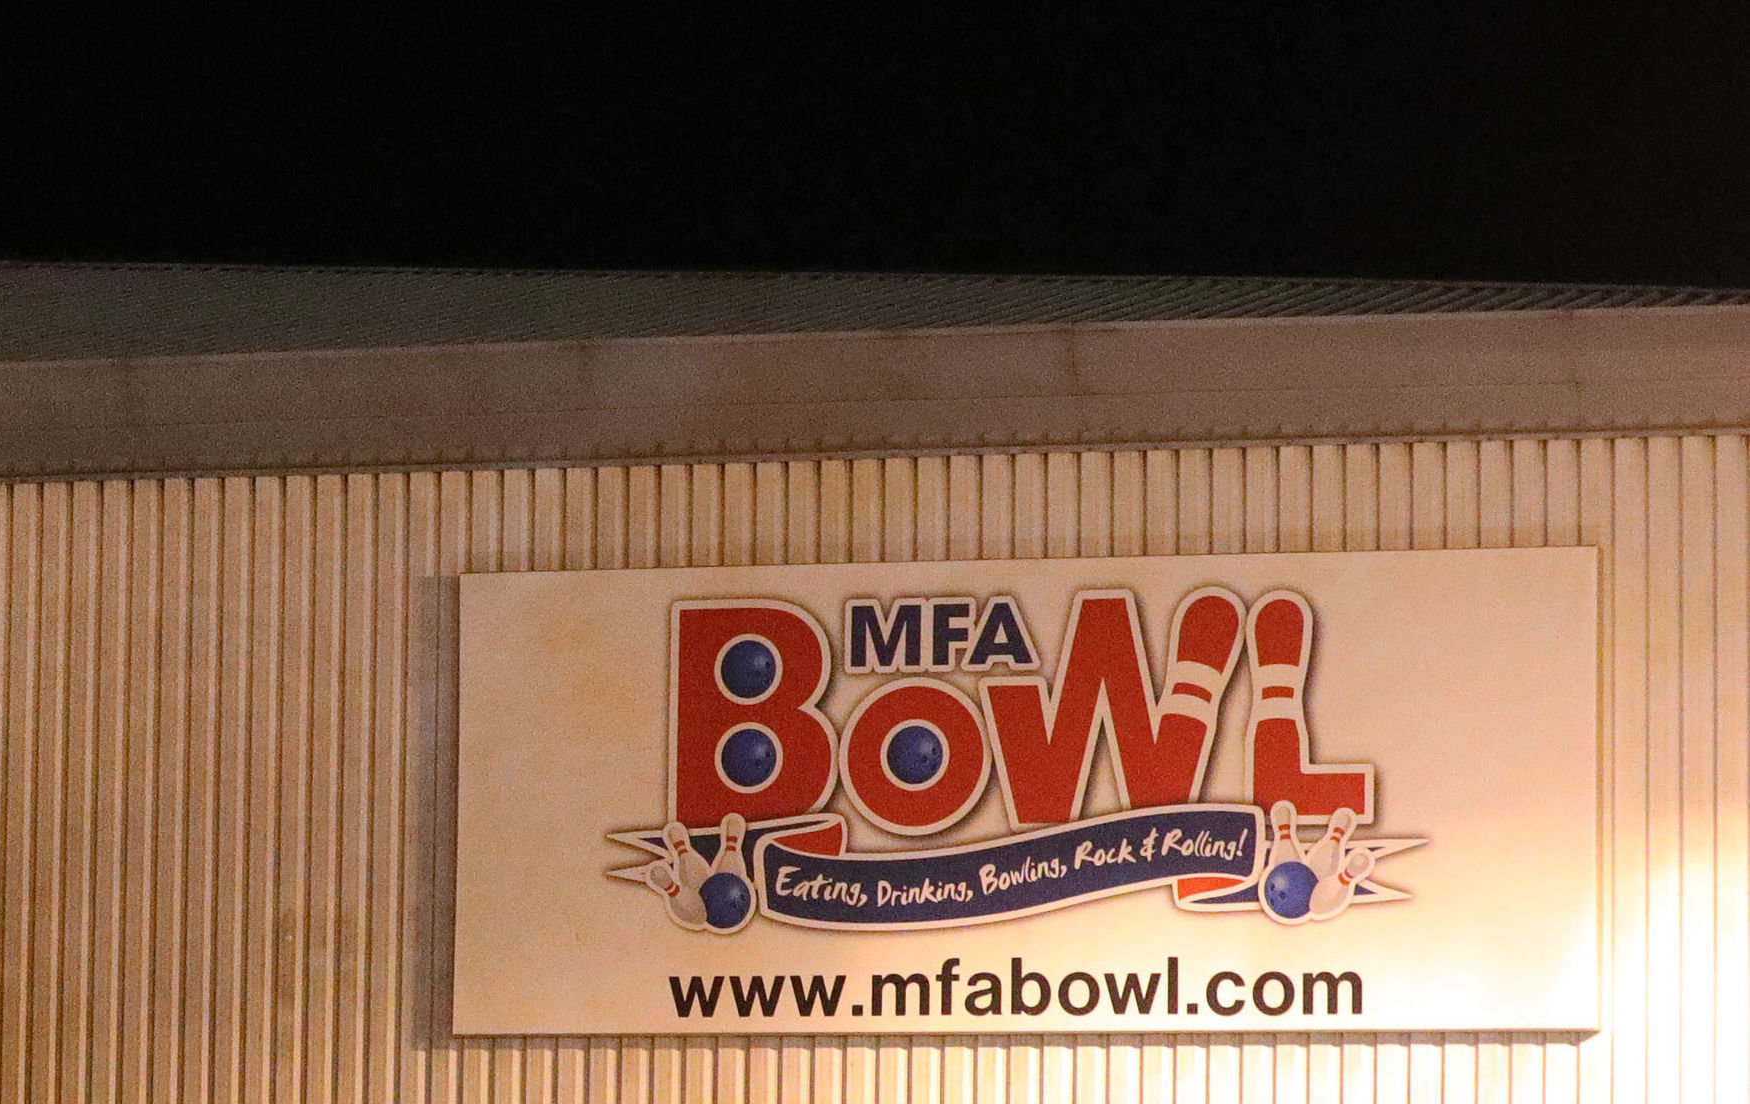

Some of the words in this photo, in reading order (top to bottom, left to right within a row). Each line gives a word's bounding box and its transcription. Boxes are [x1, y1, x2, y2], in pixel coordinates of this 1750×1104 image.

[851, 603, 1035, 669] MFA
[673, 594, 1367, 829] BOWL
[775, 865, 868, 908] Eating,
[876, 877, 974, 908] Drinking,
[978, 856, 1067, 895] Bowling,
[1074, 839, 1139, 870] Rock
[1140, 827, 1158, 861] &
[1161, 828, 1249, 861] Rolling!
[668, 957, 1364, 1018] www.mfabowl.com
